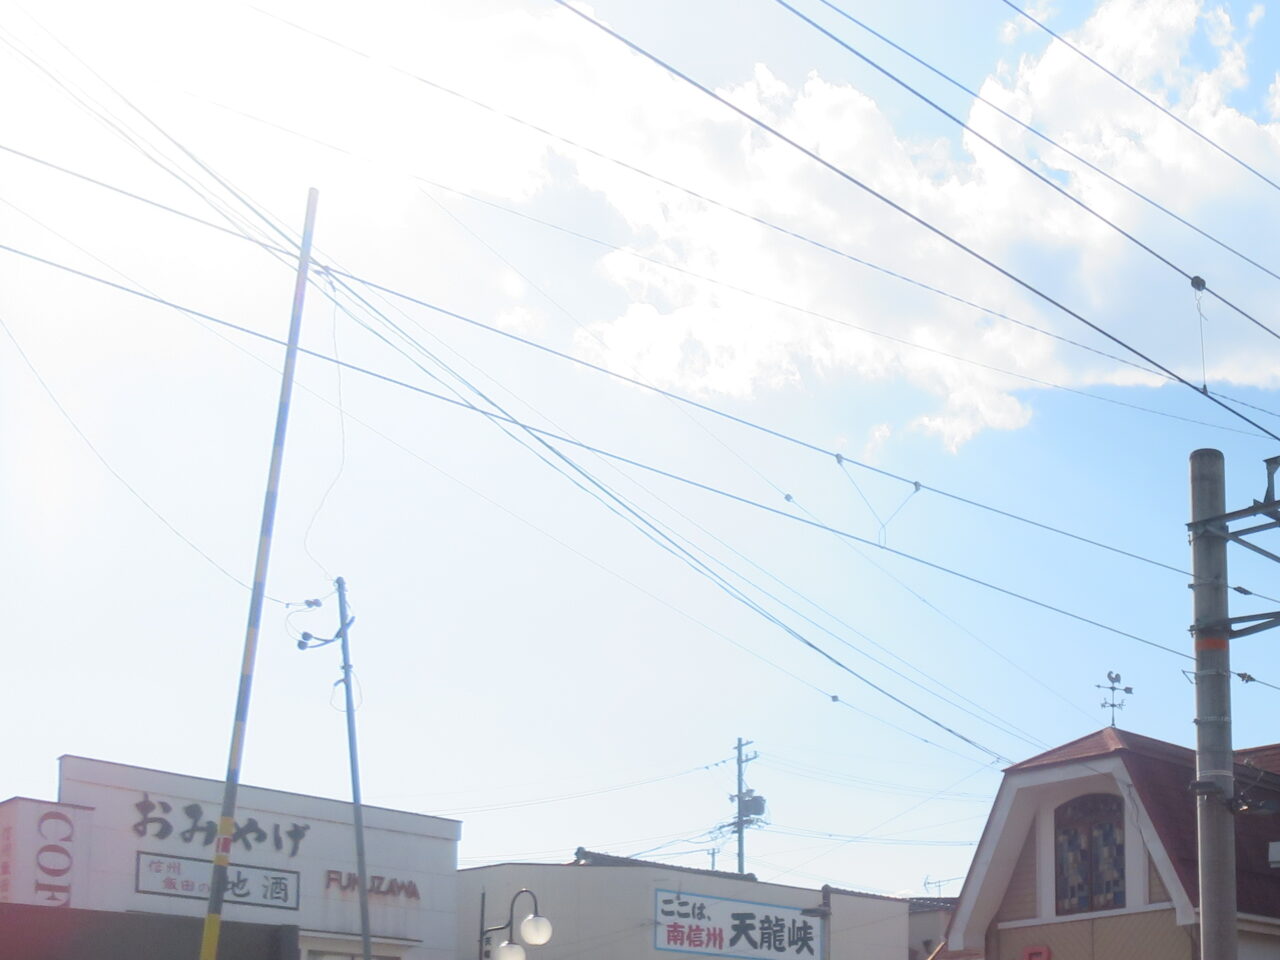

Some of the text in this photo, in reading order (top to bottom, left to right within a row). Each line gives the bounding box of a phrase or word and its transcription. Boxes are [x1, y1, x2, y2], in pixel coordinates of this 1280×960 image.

[132, 791, 311, 858] おみやげ
[148, 861, 182, 876] 信州
[162, 876, 211, 894] 飯田の
[222, 871, 290, 903] 地酒
[666, 921, 724, 950] 南信州
[729, 912, 815, 957] 天龍峡
